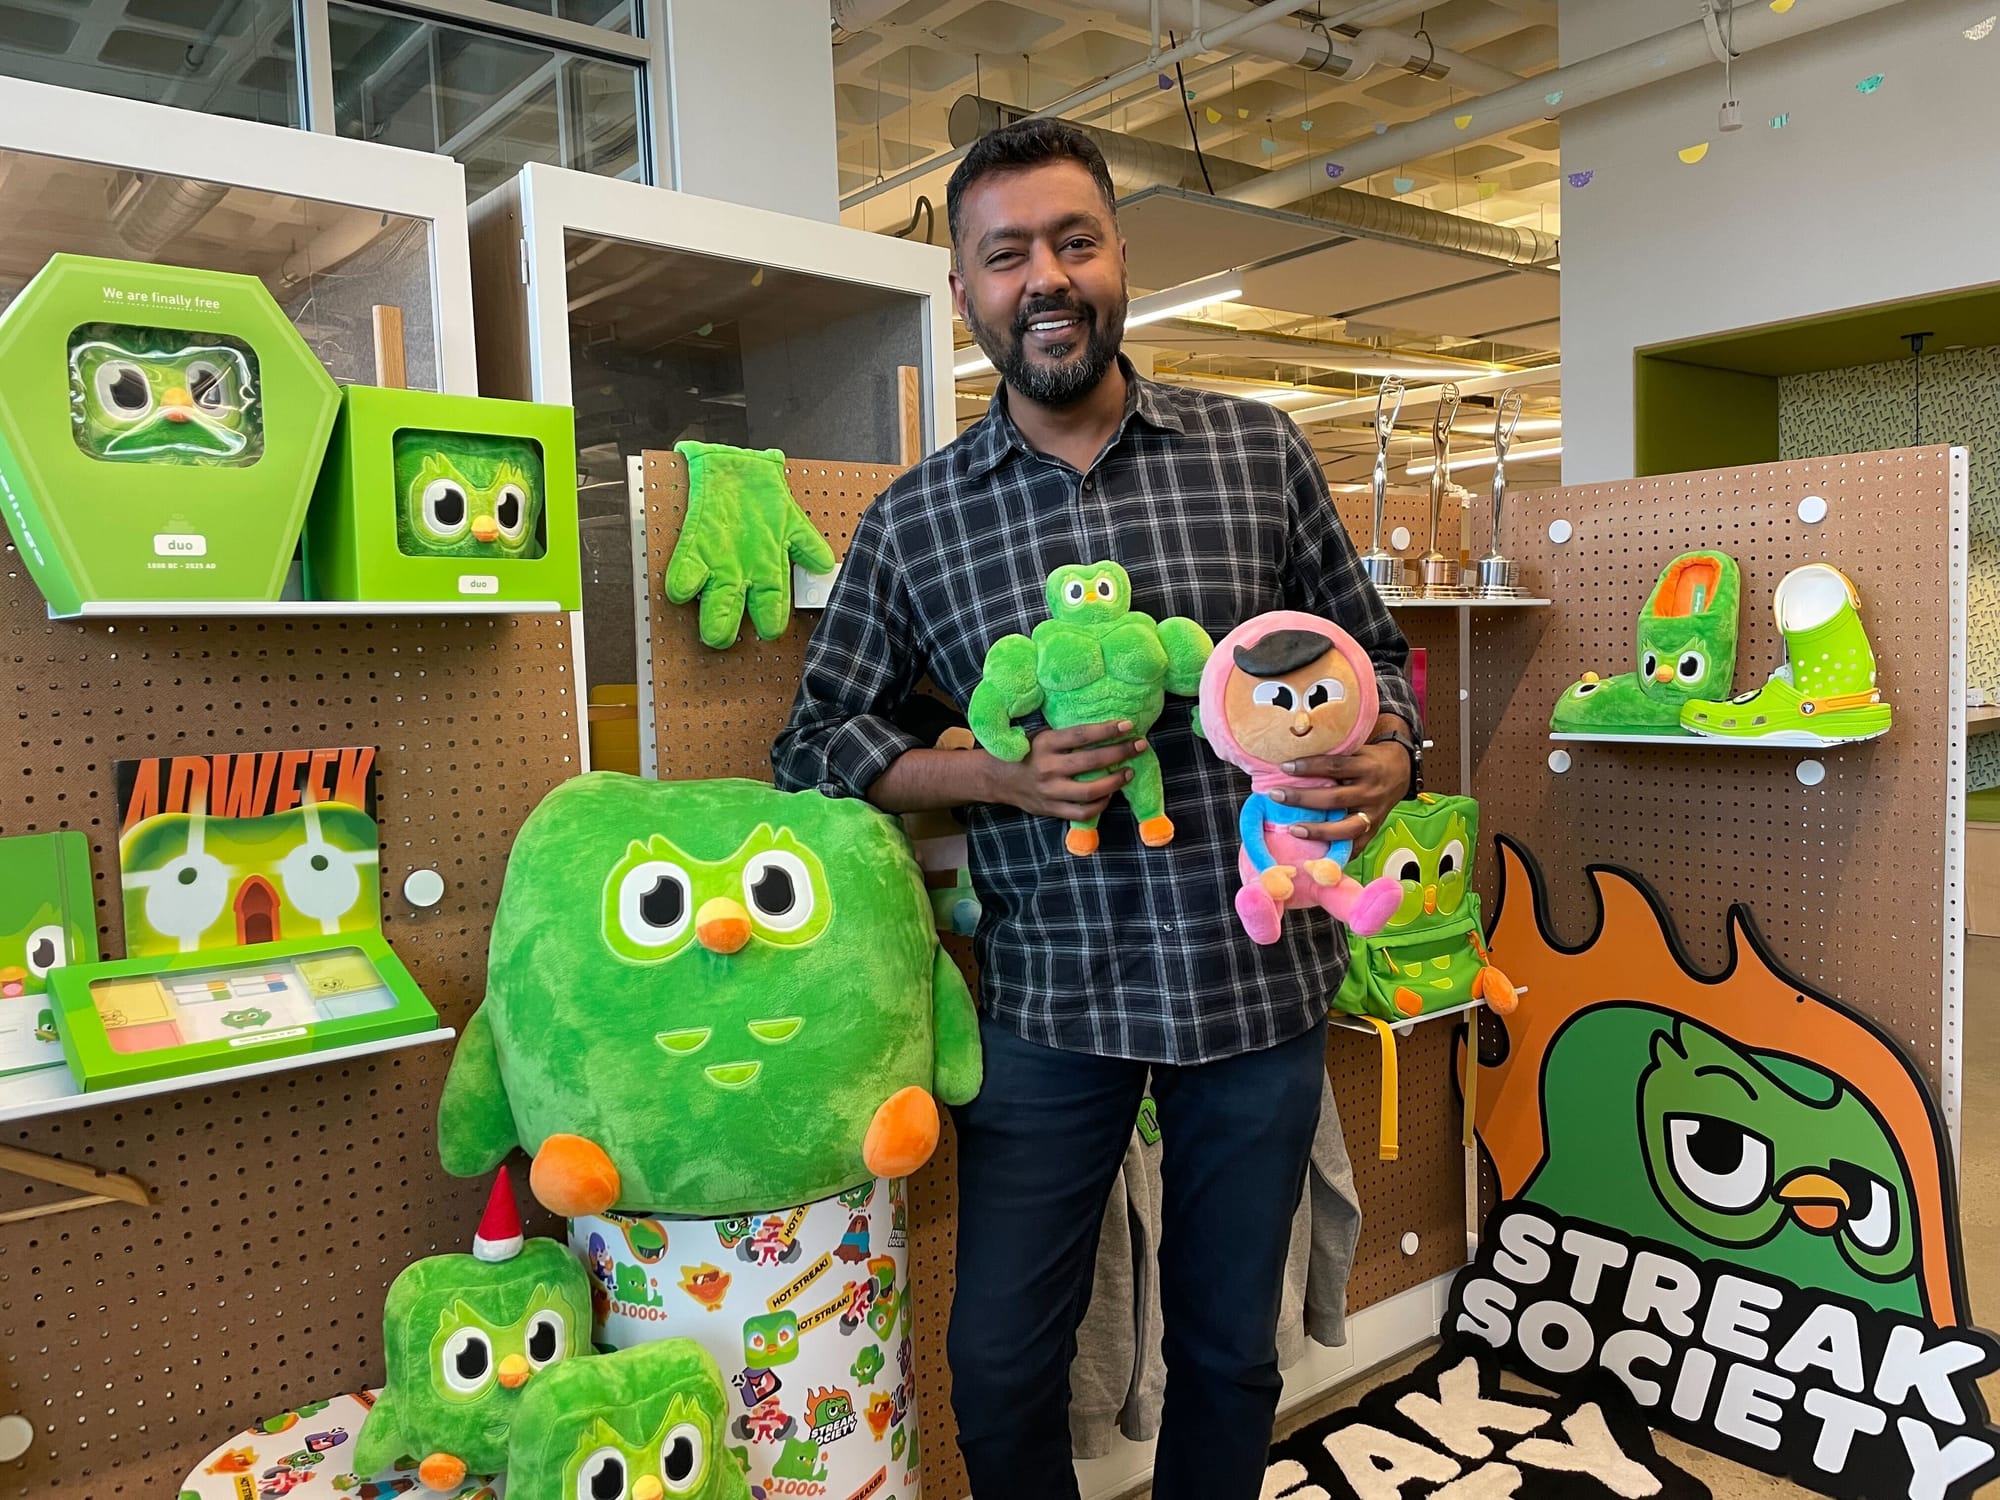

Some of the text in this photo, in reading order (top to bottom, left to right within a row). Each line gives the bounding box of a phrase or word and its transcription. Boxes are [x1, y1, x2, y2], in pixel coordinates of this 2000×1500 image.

[102, 287, 220, 309] We are finally free
[168, 540, 193, 551] duo
[470, 579, 487, 588] duo
[119, 747, 376, 834] ADWEEK
[784, 1215, 799, 1238] HOT
[772, 1288, 792, 1308] HOT
[621, 1303, 668, 1321] 1000+
[1492, 1213, 1987, 1426] STREAK
[1456, 1277, 1996, 1500] SOCIETY
[811, 1414, 856, 1438] STREAK
[815, 1421, 857, 1446] OCIETY
[774, 1479, 827, 1497] 1000+
